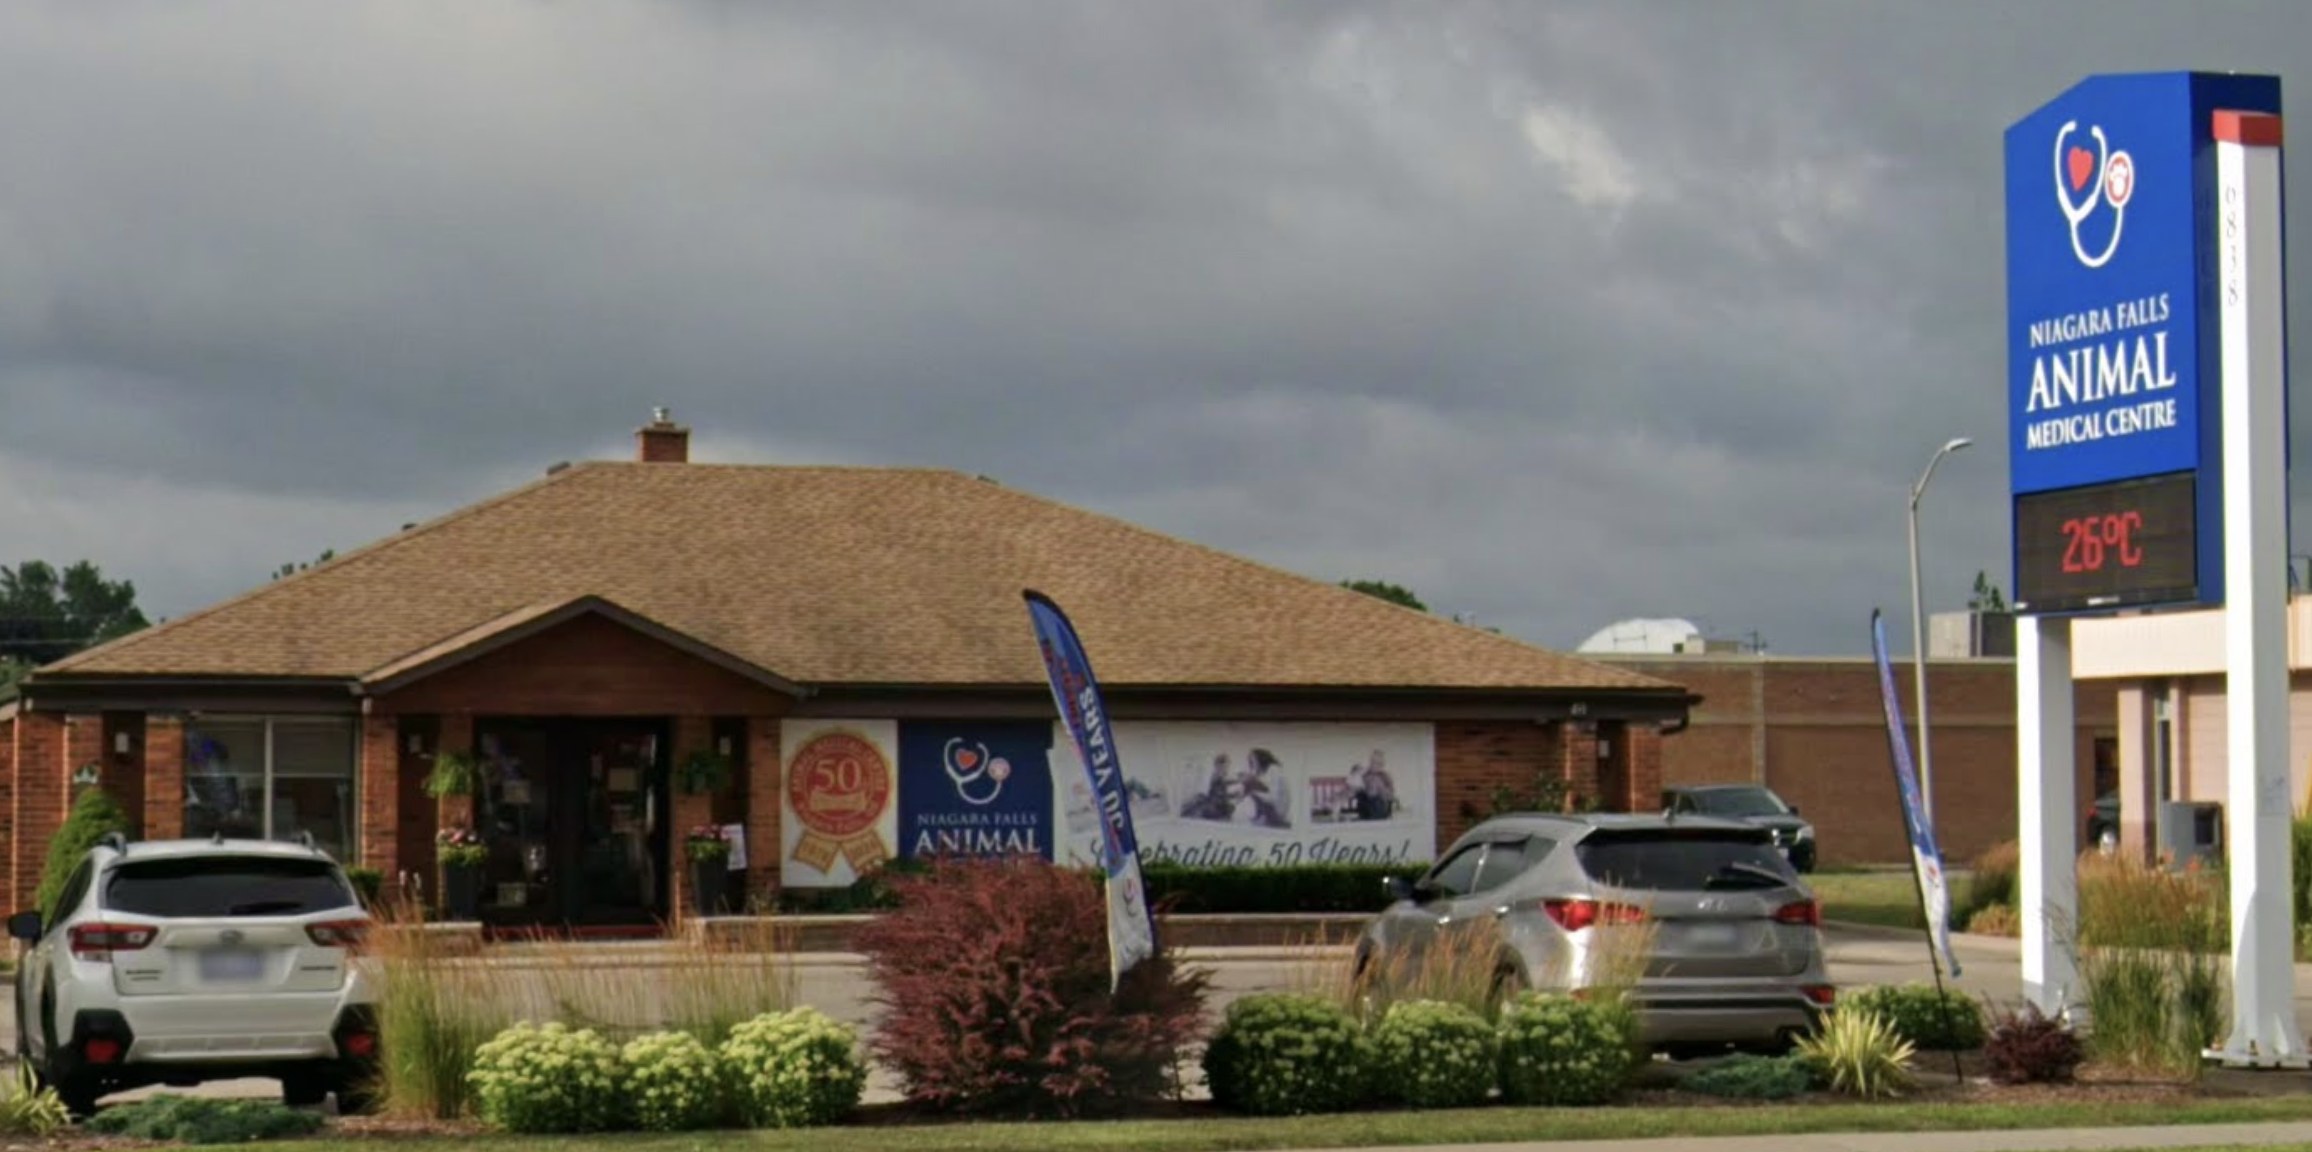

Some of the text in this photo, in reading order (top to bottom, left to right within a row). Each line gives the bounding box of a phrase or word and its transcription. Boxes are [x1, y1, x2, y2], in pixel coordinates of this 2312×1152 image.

[2029, 292, 2170, 348] NIAGARA FALLS
[2025, 331, 2177, 413] ANIMAL
[2026, 398, 2177, 450] MEDICAL CENTRE
[1079, 686, 1113, 787] YEARS
[812, 758, 861, 792] 50
[917, 812, 1038, 826] NIAGARA FALLS
[914, 827, 1041, 855] ANIMAL
[1270, 841, 1303, 866] 50
